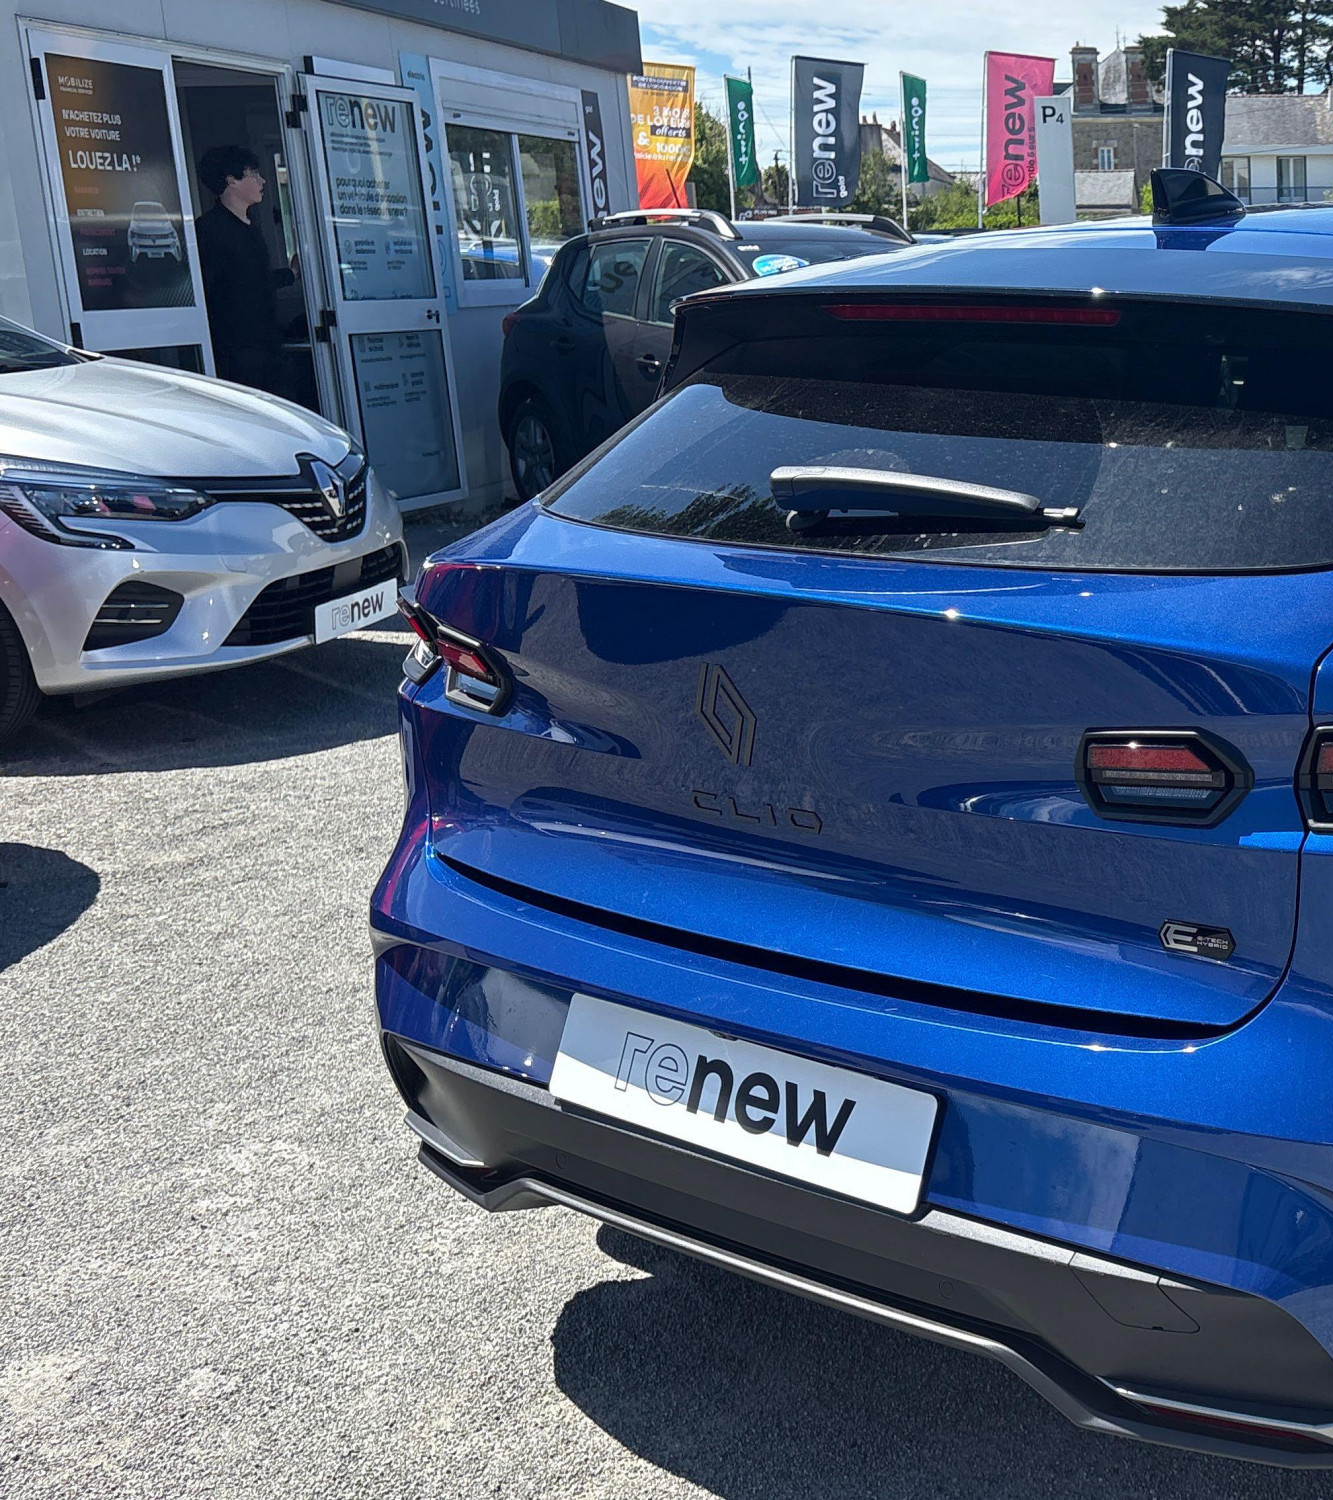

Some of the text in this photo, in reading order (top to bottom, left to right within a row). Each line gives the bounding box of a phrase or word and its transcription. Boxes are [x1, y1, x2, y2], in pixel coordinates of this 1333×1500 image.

[58, 75, 93, 89] MOBILIZE
[62, 109, 121, 125] N'ACHETEZ PLUS
[325, 96, 396, 133] renew
[630, 113, 645, 125] DE
[1041, 106, 1064, 124] P4
[65, 126, 121, 141] VOTRE VOITURE
[637, 131, 649, 146] &
[655, 124, 686, 137] offerts
[812, 76, 837, 198] renew
[1002, 74, 1026, 197] renew
[68, 149, 113, 170] LOUEZ
[114, 153, 131, 172] LA
[332, 591, 384, 631] renew
[690, 789, 823, 837] CLIO
[1196, 941, 1229, 950] HYBRID
[613, 1031, 857, 1158] renew
